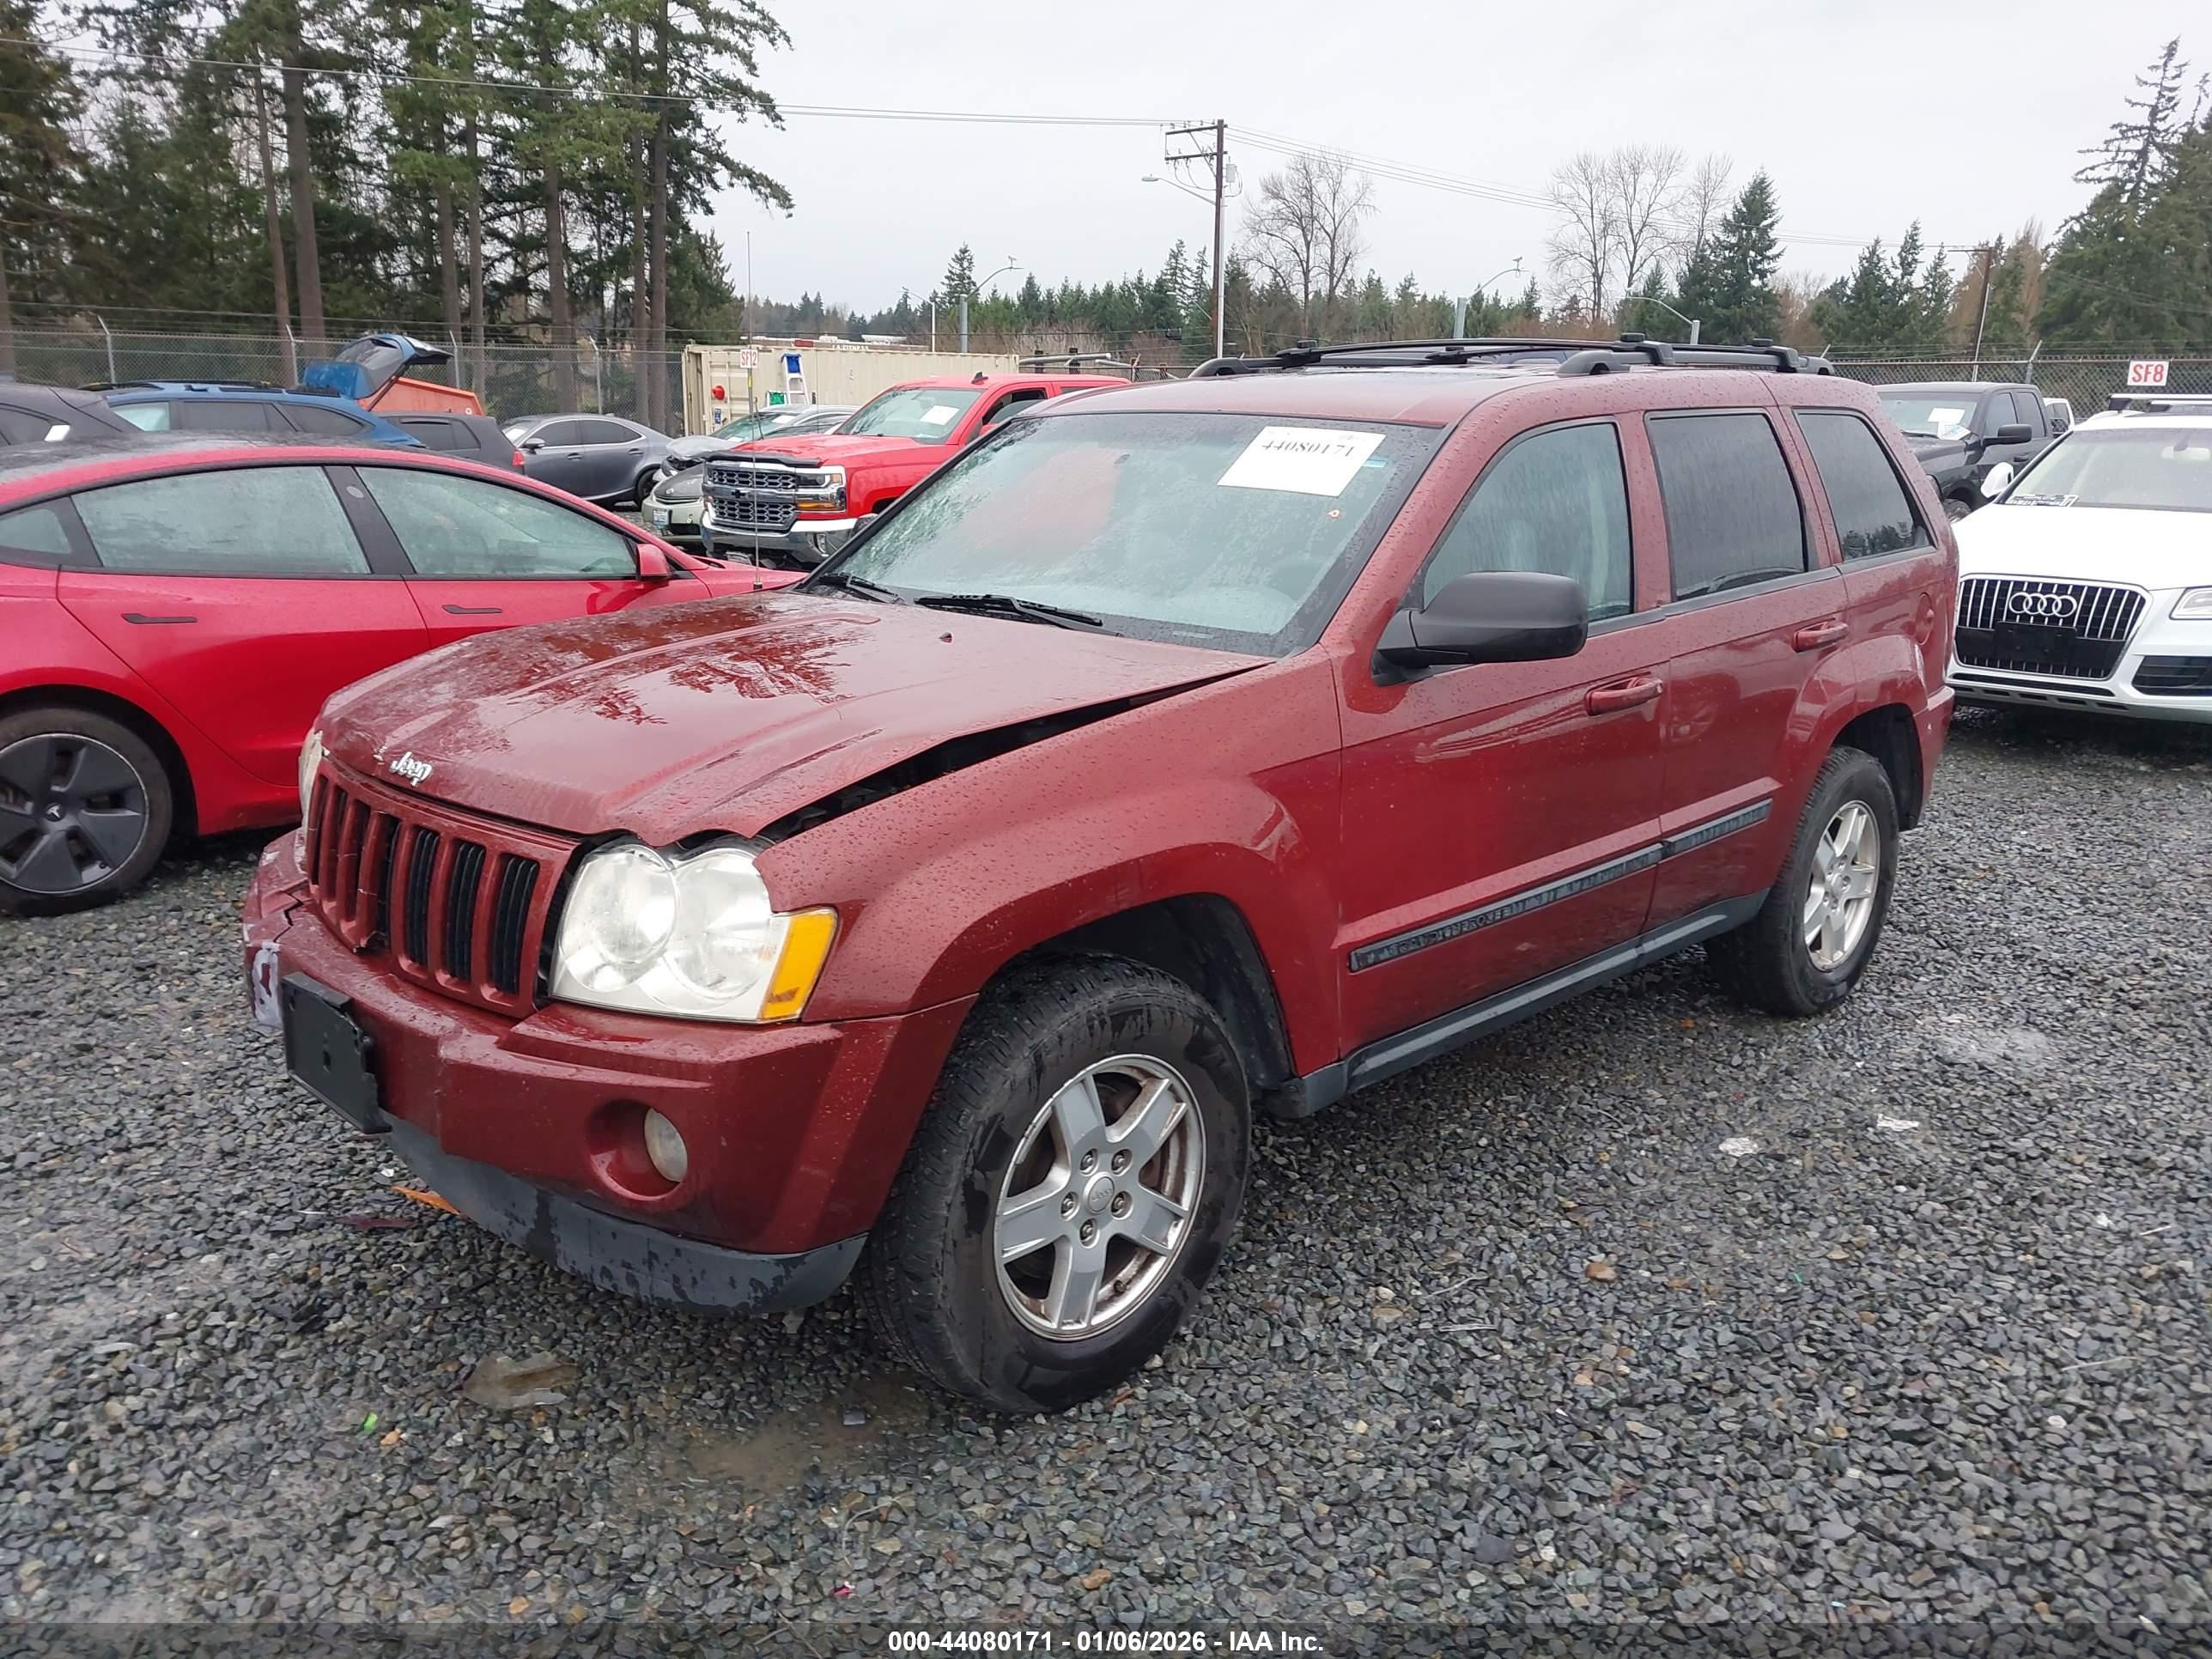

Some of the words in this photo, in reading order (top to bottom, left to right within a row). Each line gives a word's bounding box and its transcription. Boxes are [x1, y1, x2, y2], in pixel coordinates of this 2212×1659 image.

[741, 350, 757, 366] SF12
[2132, 363, 2164, 383] SF8
[1261, 440, 1355, 457] 44080171
[390, 751, 432, 787] Jeep
